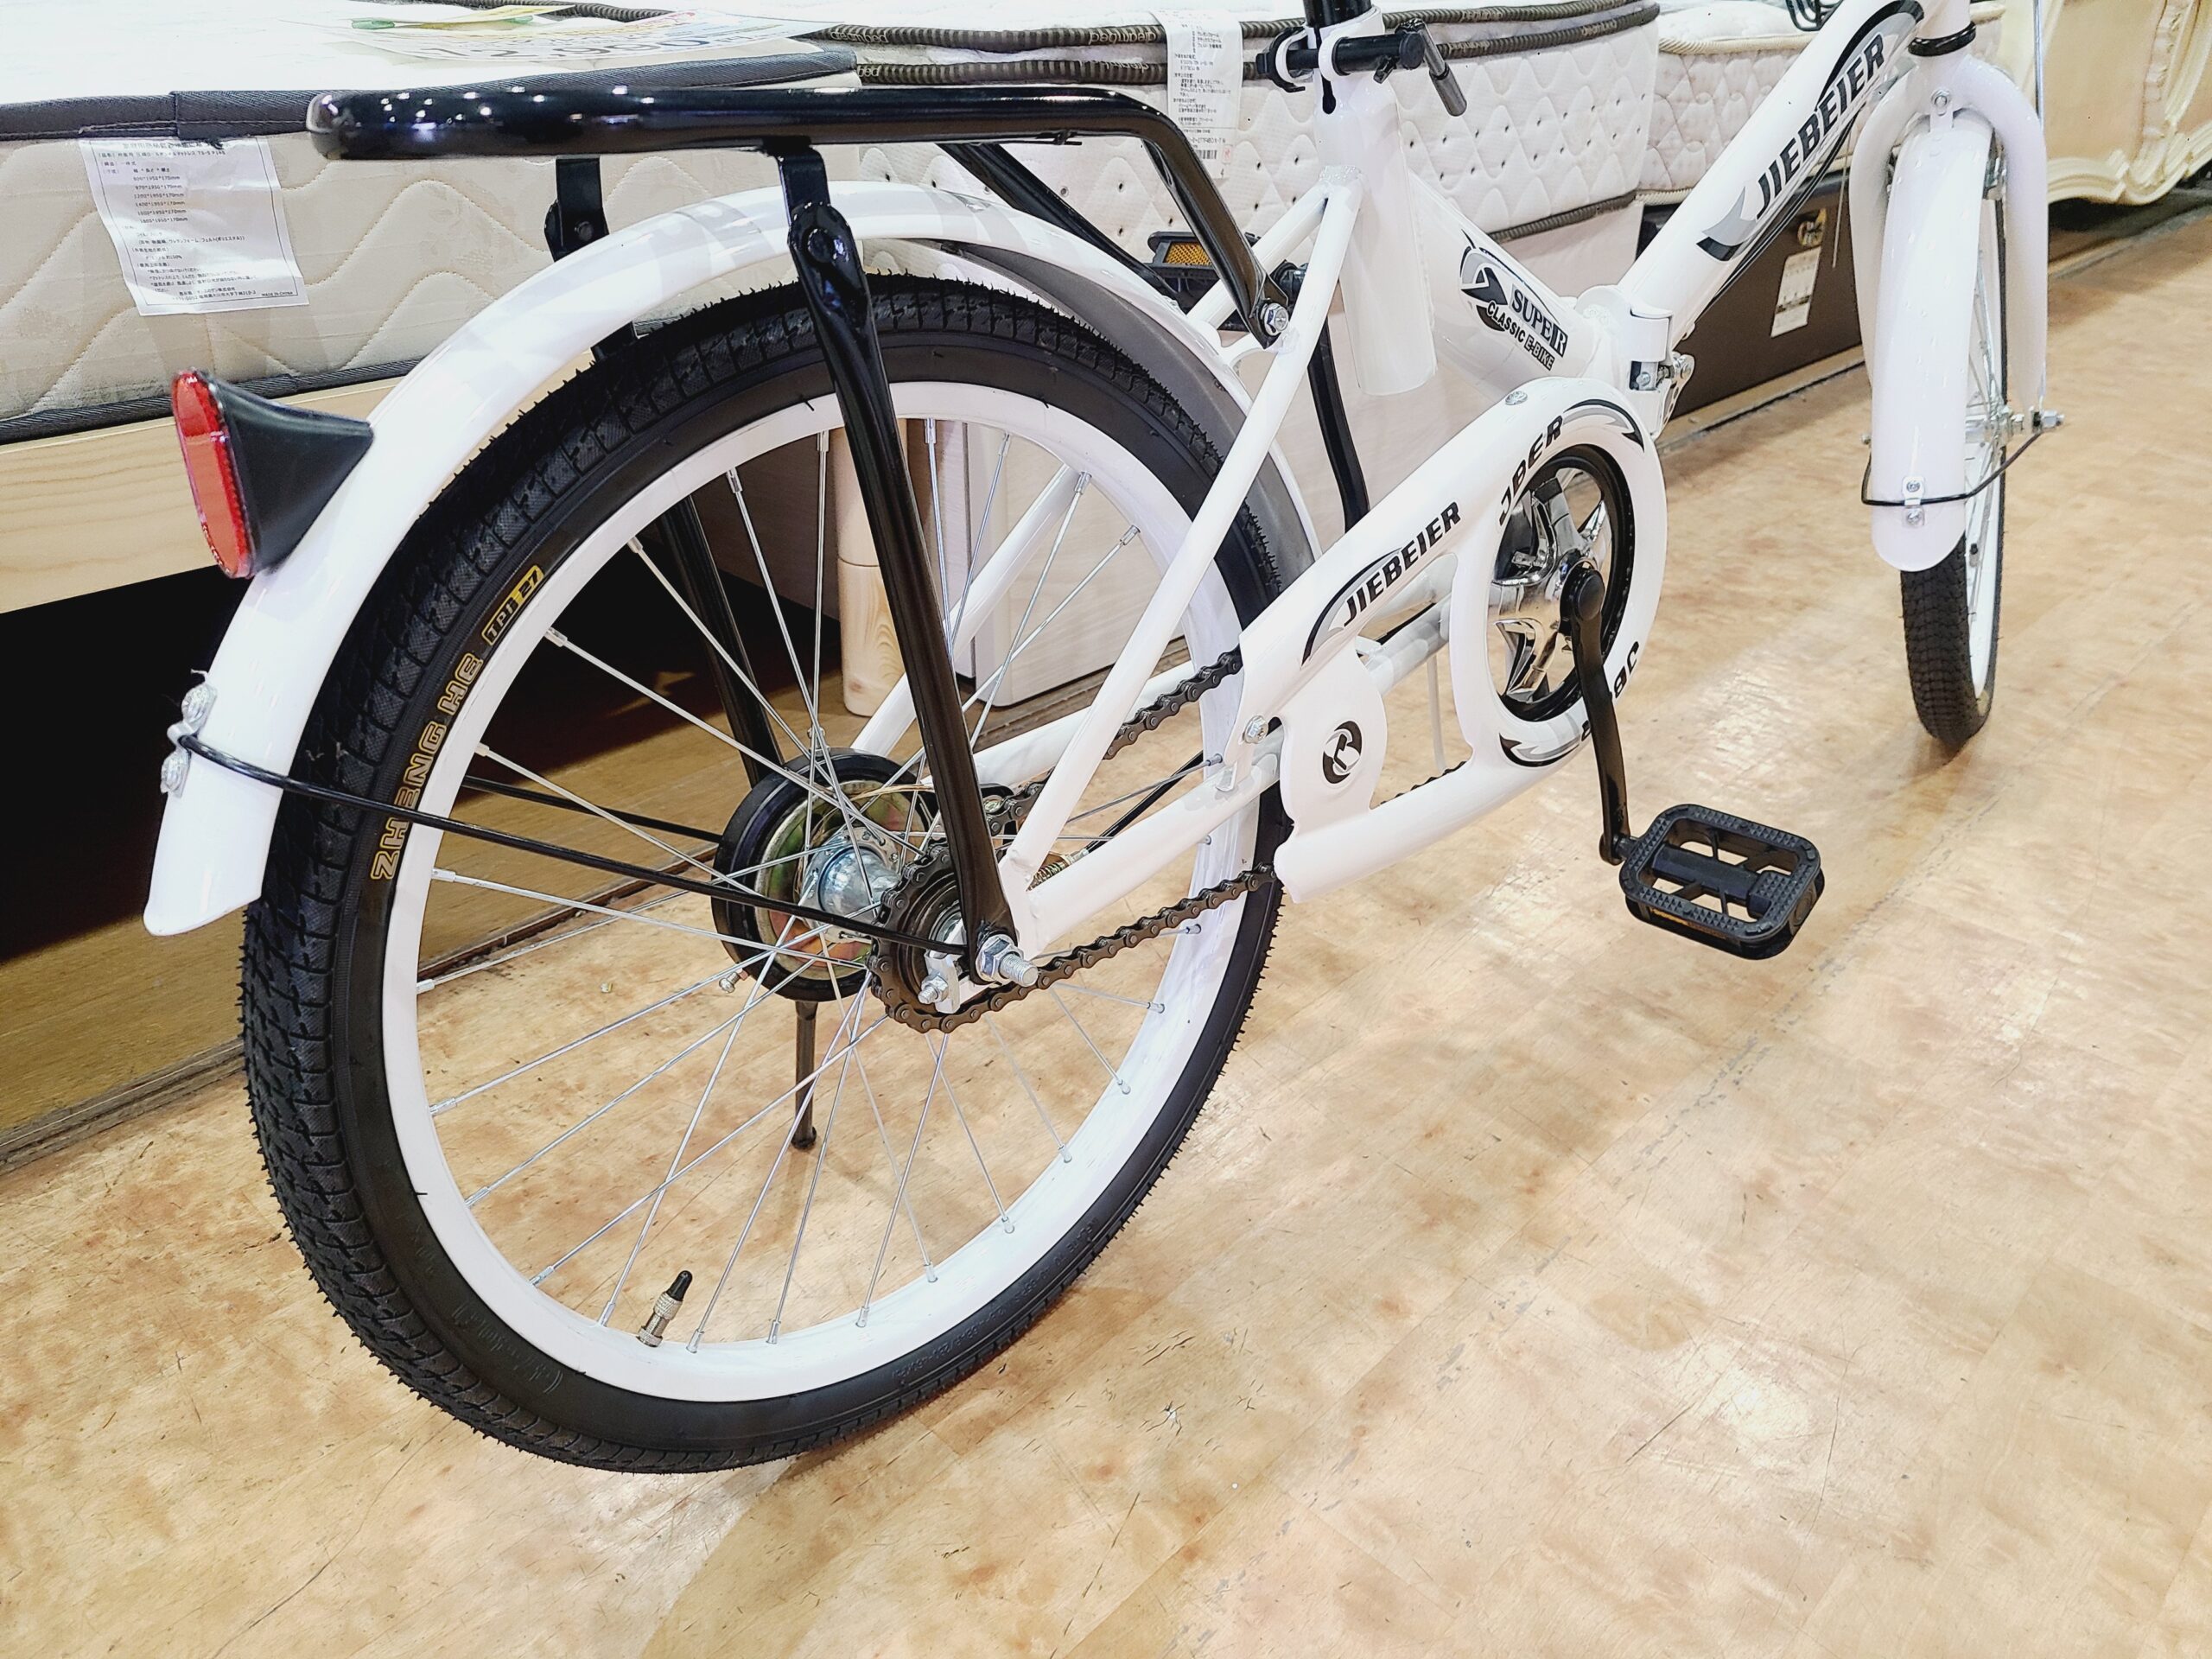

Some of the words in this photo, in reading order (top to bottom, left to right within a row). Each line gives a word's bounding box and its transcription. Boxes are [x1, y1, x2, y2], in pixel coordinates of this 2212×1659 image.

[1757, 34, 1885, 219] JIEBEIER
[1487, 302, 1525, 342] CLASSIC
[1524, 334, 1555, 372] E-BIKE
[1512, 289, 1568, 357] SUPER
[1499, 416, 1562, 526] JBER
[486, 604, 514, 638] TPI
[518, 569, 539, 599] 27
[1344, 502, 1461, 627] JIEBEIER
[371, 721, 448, 880] ZHENG
[437, 652, 484, 717] HE
